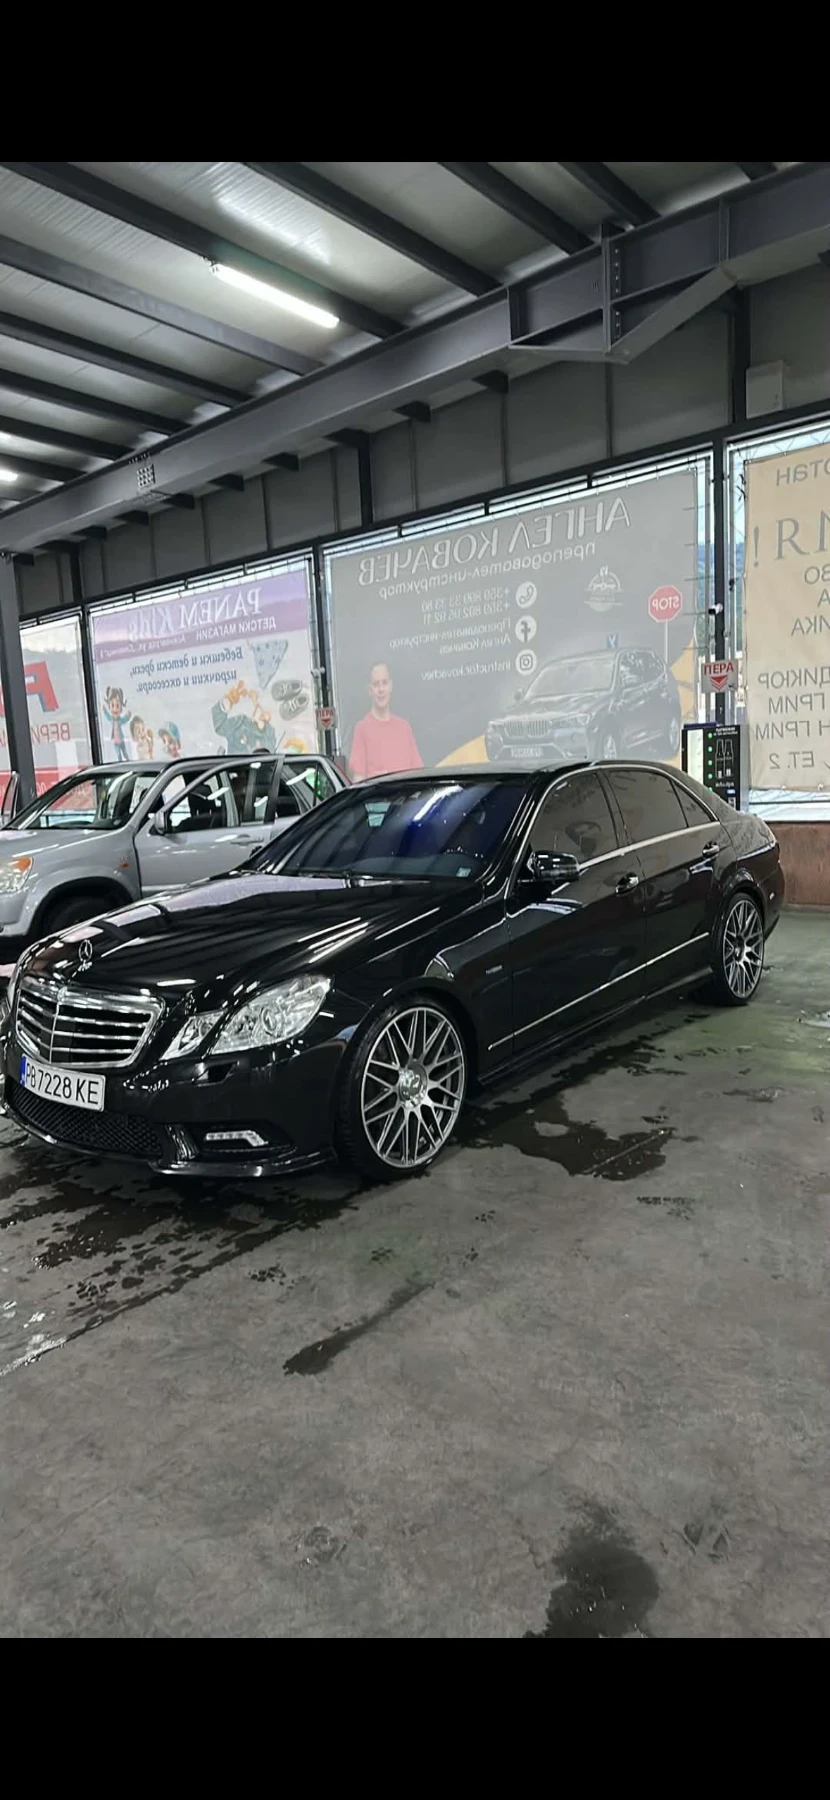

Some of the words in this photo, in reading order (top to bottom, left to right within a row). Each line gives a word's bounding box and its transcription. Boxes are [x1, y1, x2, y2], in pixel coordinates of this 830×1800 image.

[703, 661, 734, 675] ПЕРА
[37, 1069, 72, 1099] 7228
[75, 1078, 99, 1105] KE
